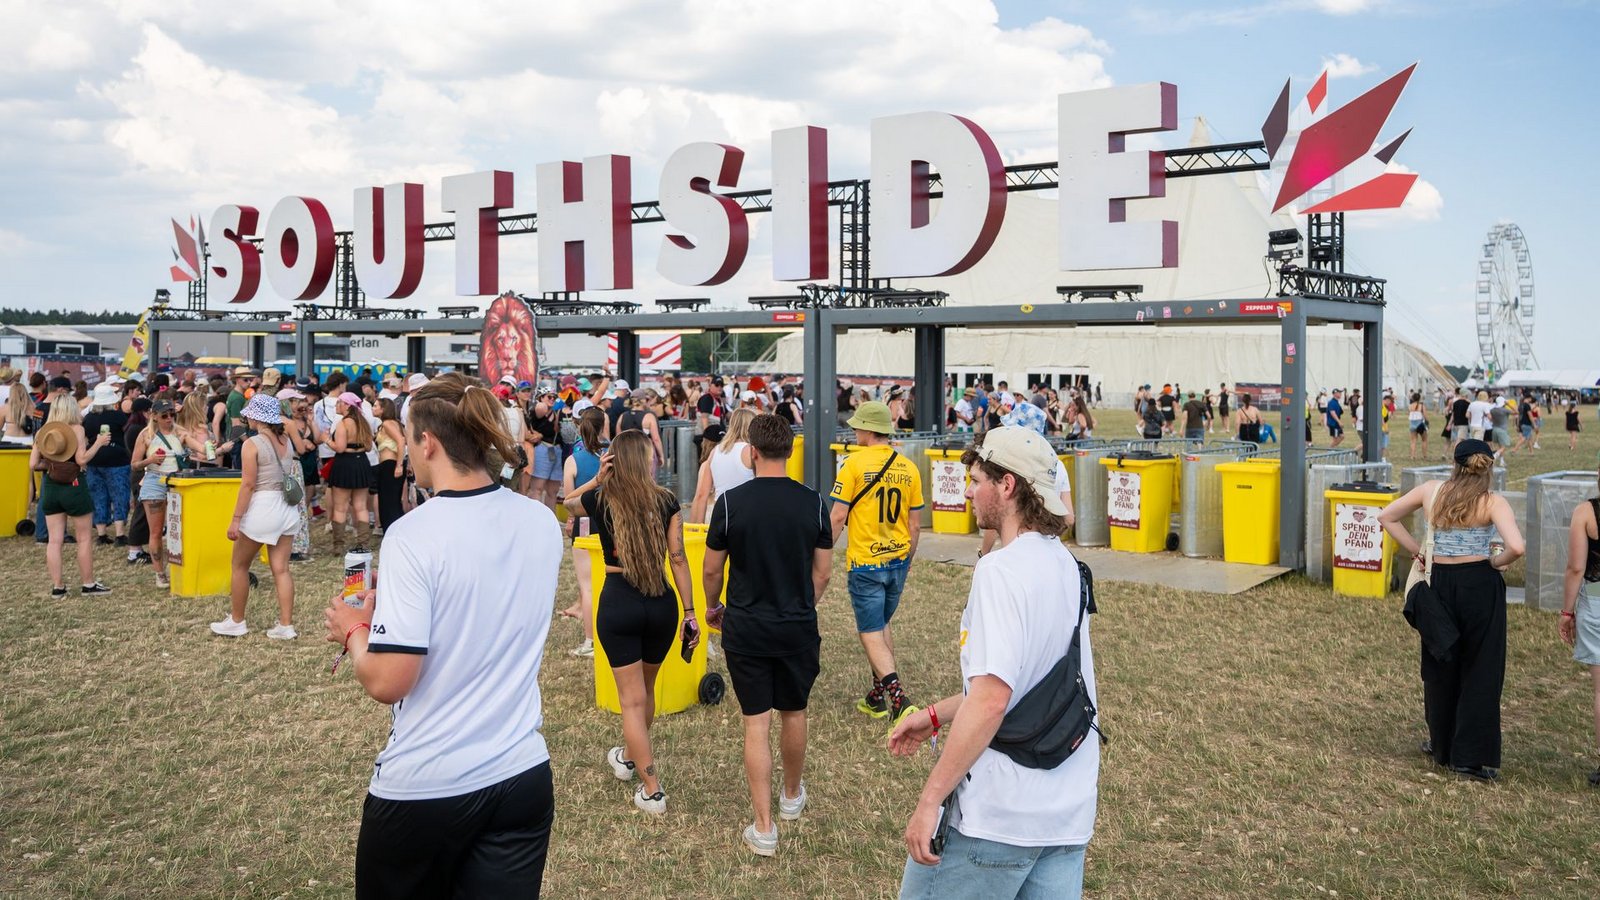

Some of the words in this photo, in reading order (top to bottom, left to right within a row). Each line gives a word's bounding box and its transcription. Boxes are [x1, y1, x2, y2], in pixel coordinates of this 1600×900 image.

[206, 81, 1179, 304] SOUTHSIDE
[1113, 487, 1135, 496] SPENDE
[875, 486, 902, 524] 10
[1115, 501, 1134, 510] PFAND
[1342, 522, 1376, 533] SPENDE
[1348, 531, 1369, 540] DEIN
[1344, 539, 1374, 549] PFAND
